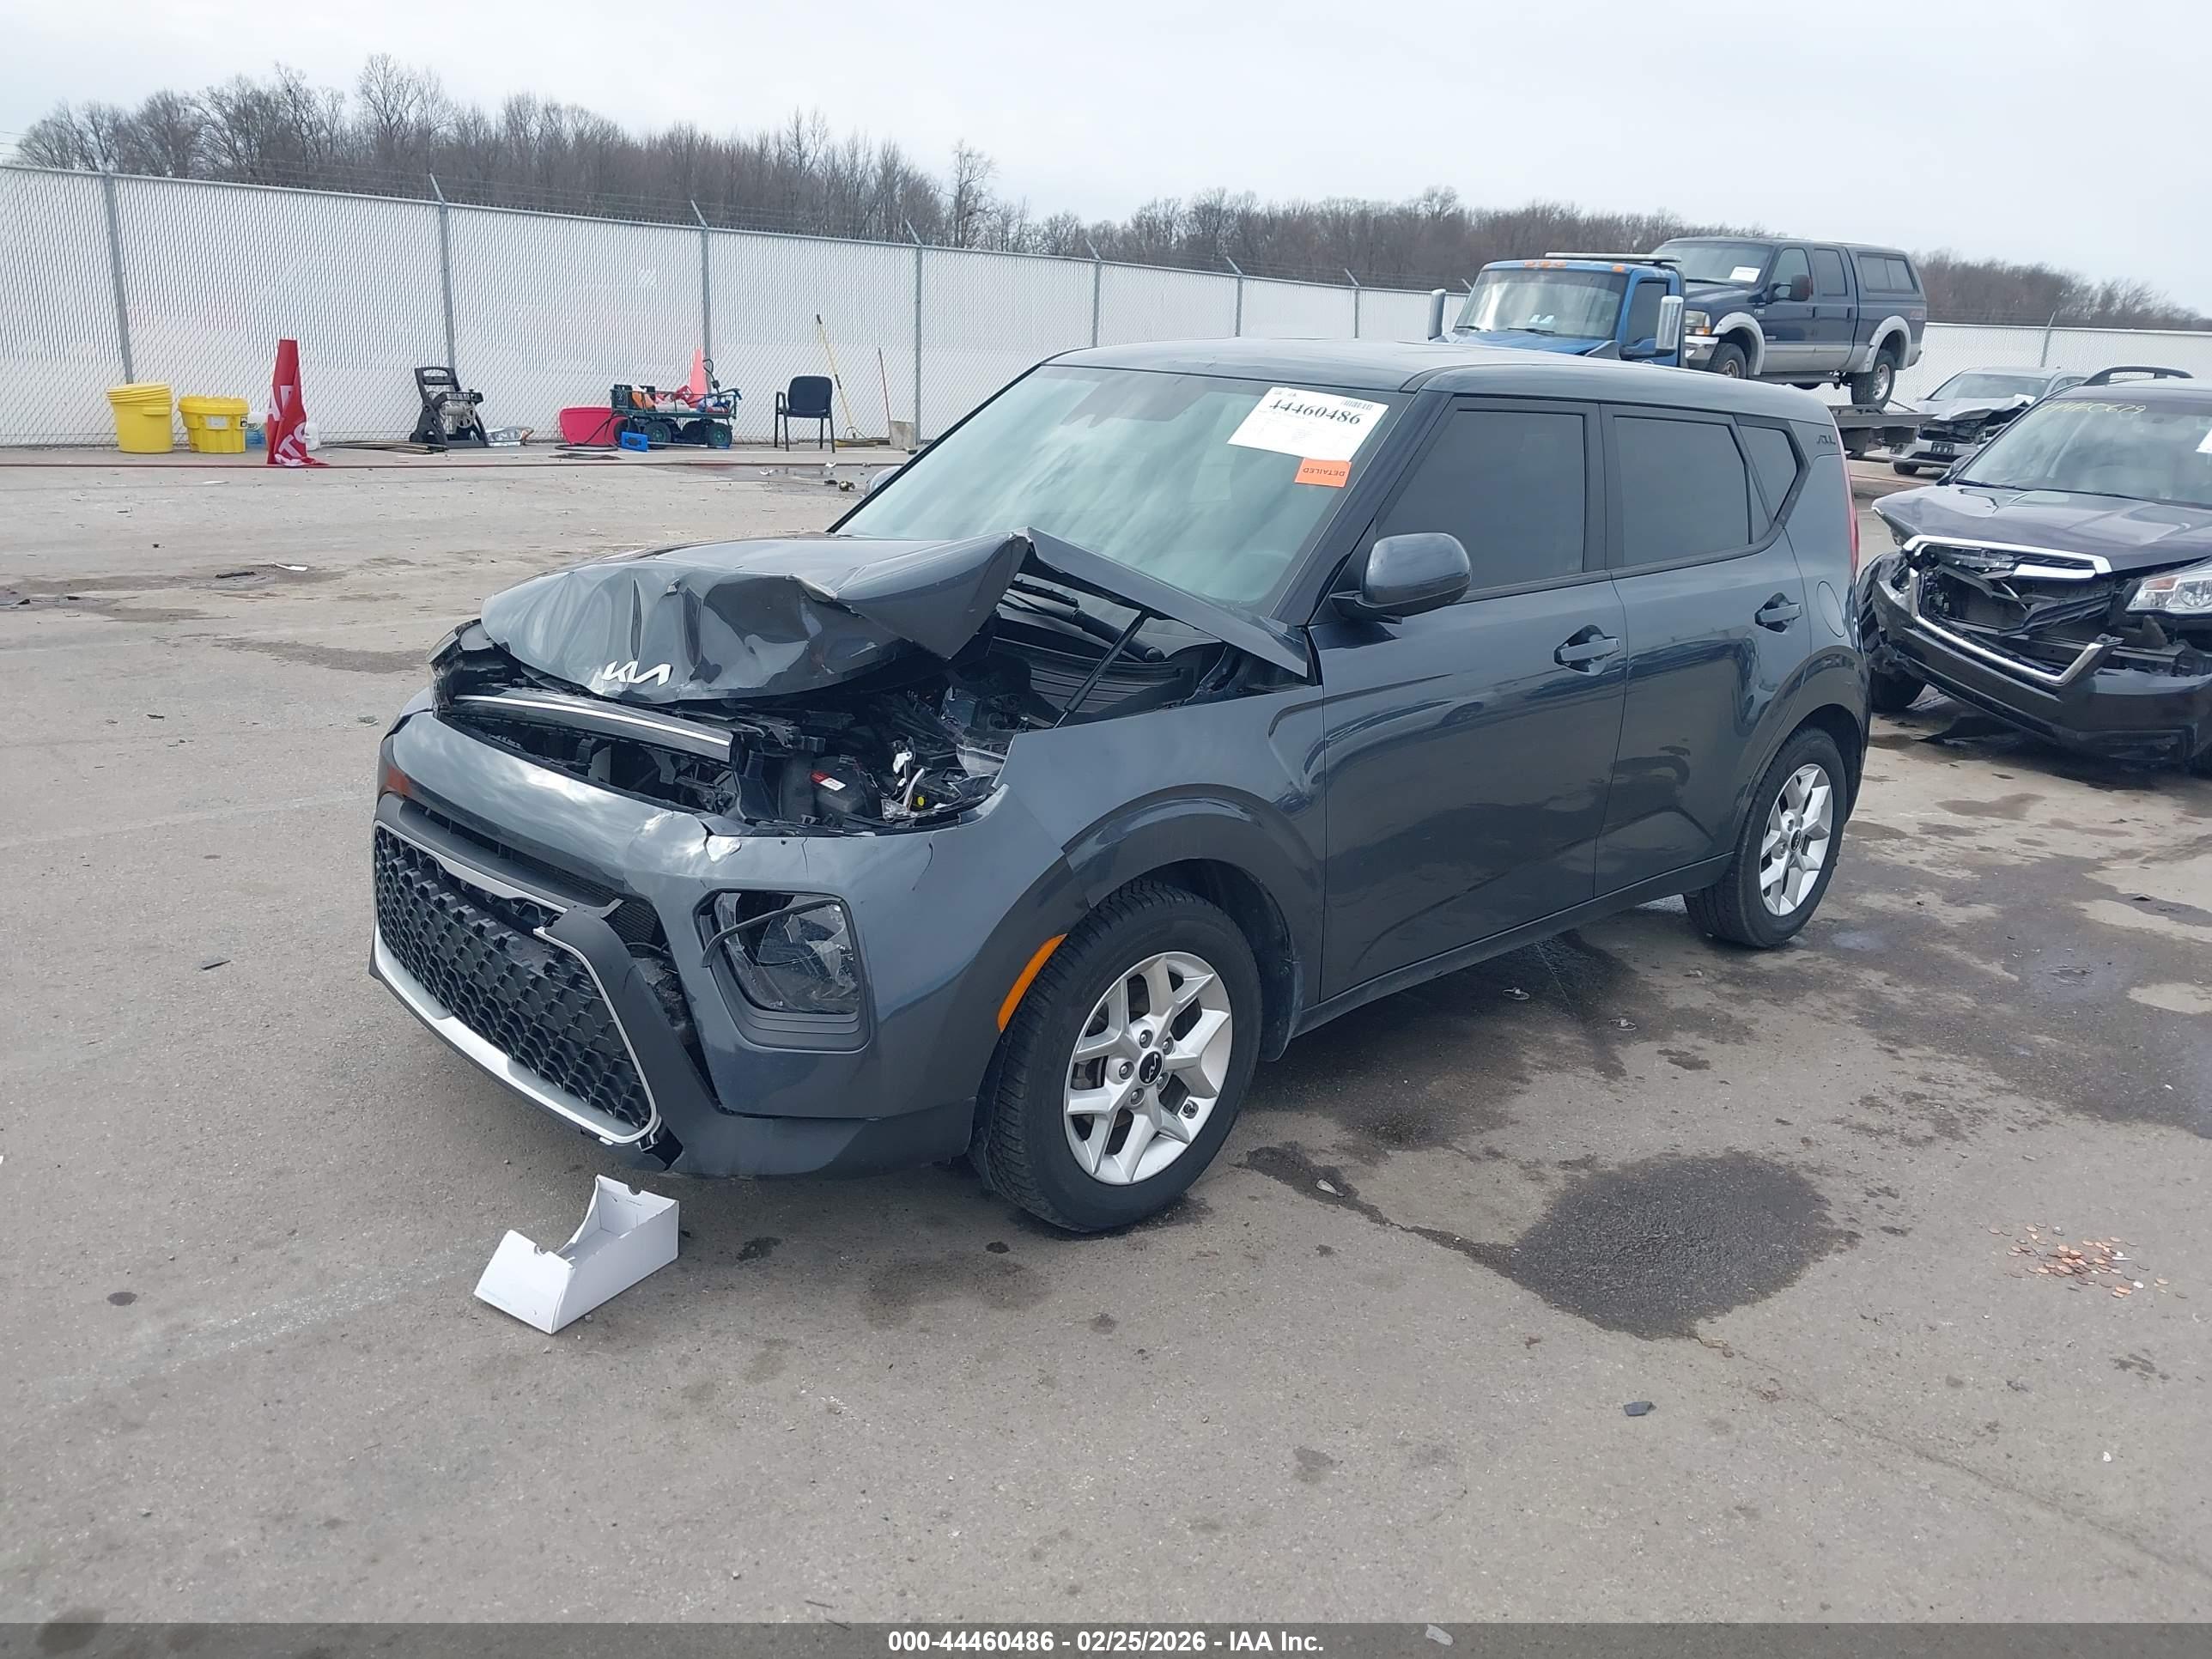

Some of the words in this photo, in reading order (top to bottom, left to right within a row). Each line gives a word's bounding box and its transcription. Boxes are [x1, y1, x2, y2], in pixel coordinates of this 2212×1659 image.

[1269, 398, 1363, 424] 44460486
[1303, 466, 1346, 477] DETAILED
[602, 660, 672, 687] KIA
